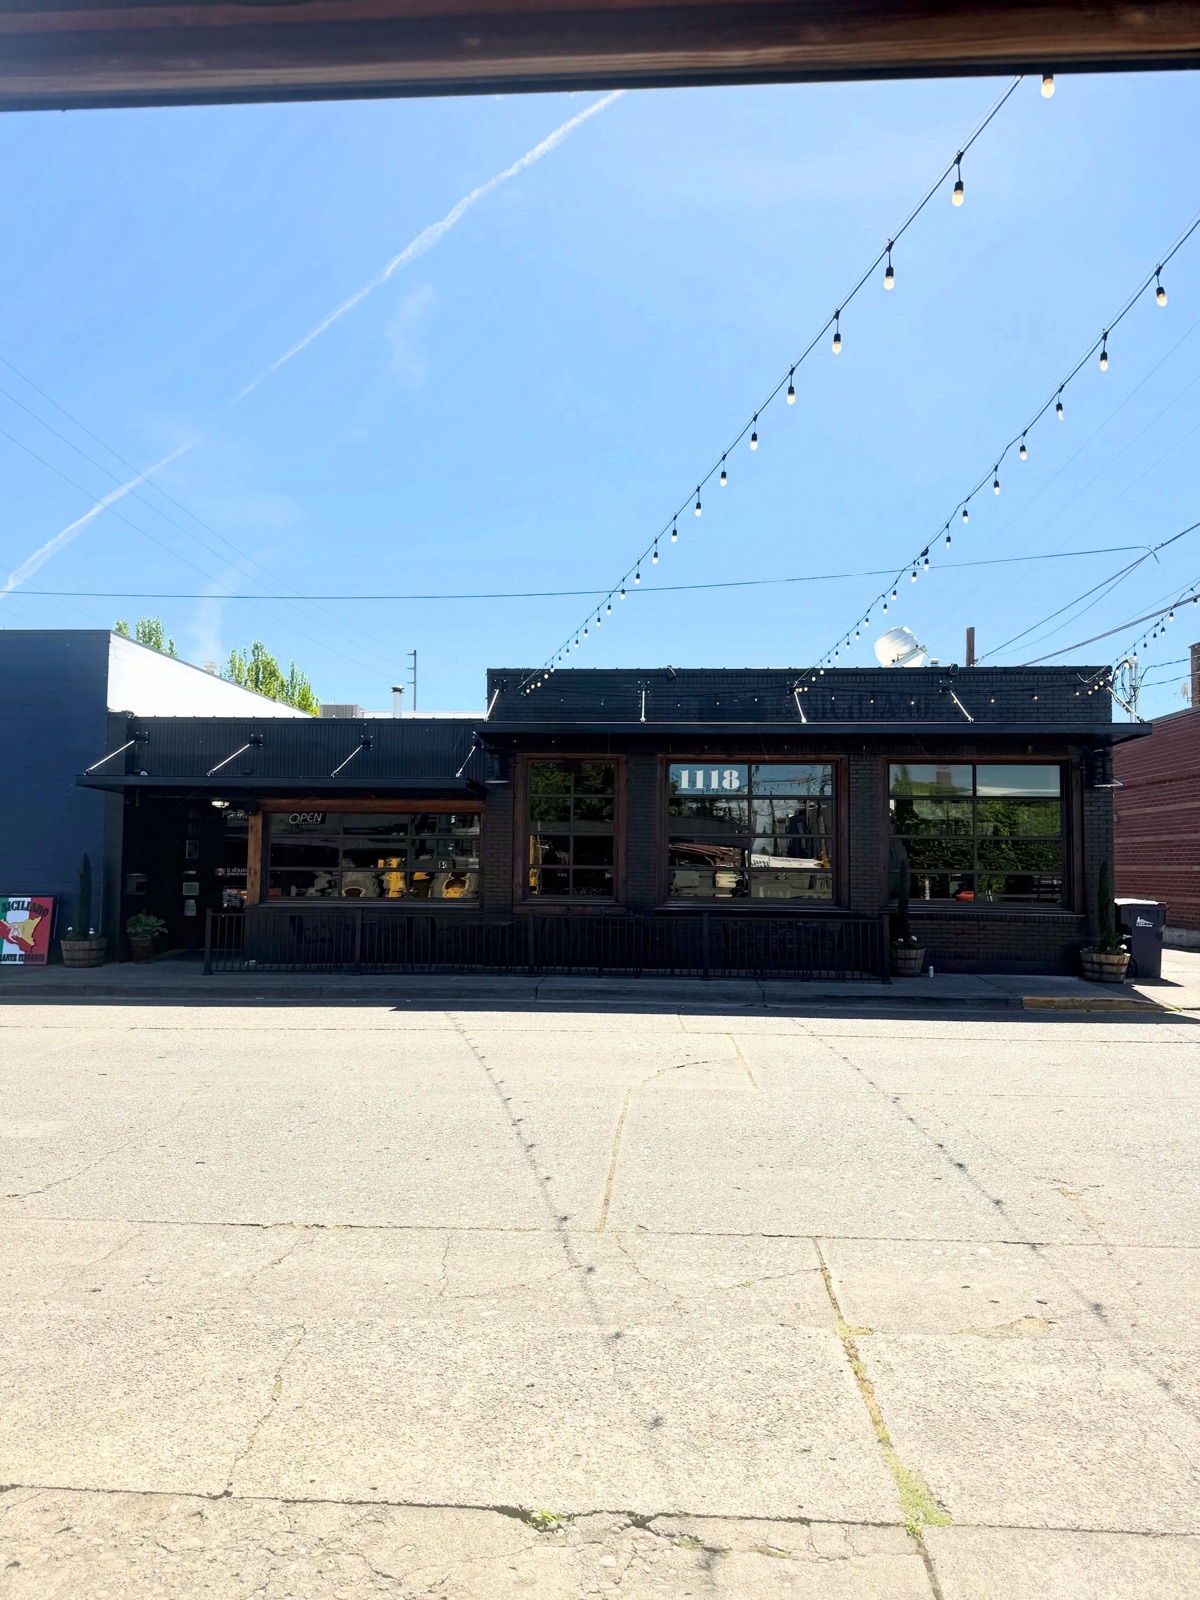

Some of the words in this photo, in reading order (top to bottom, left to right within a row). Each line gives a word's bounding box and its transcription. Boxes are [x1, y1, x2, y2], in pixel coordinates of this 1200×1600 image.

[679, 769, 740, 790] 1118
[288, 812, 323, 824] OPEN
[1, 900, 49, 917] SICILIANO
